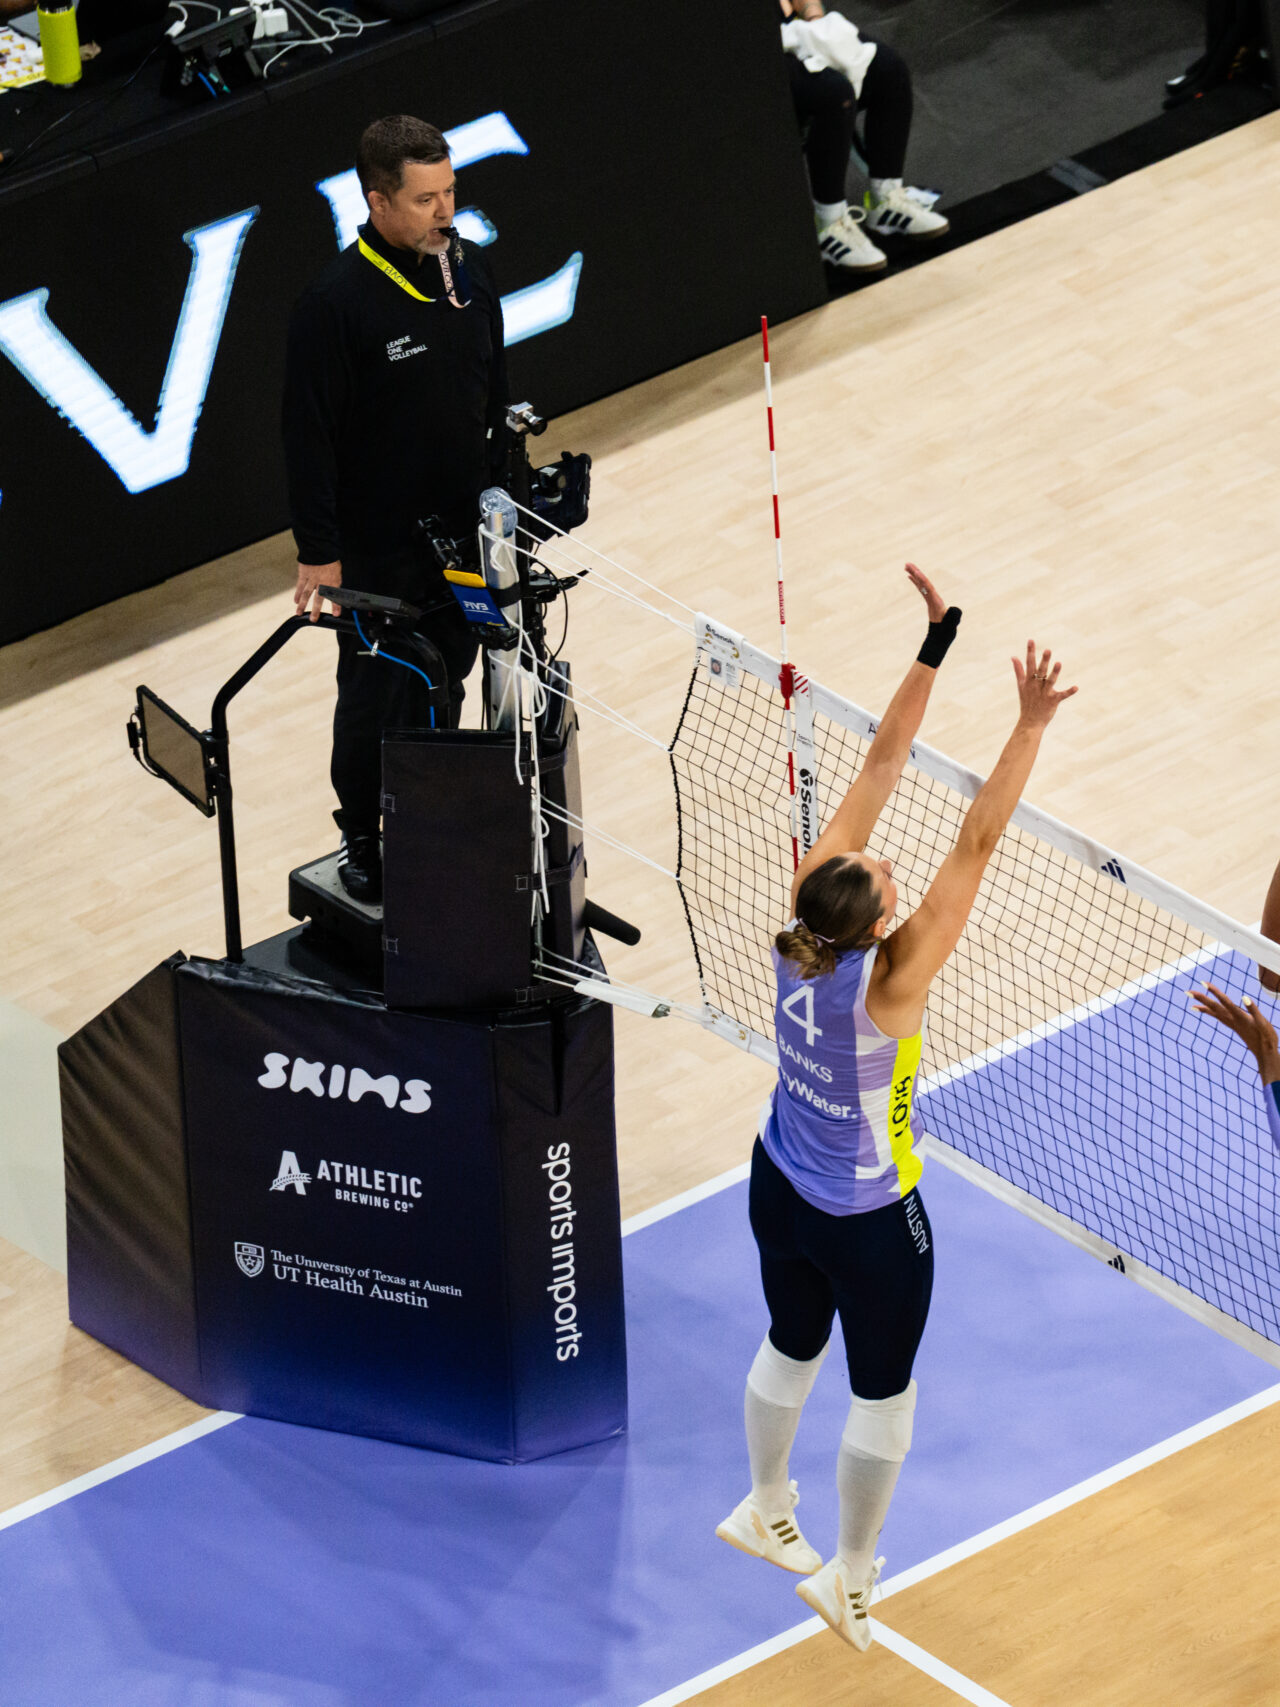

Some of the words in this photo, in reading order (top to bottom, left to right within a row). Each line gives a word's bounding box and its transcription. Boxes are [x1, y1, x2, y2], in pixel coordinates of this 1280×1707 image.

[386, 335, 411, 349] LEAGUE
[387, 346, 402, 355] ONE
[388, 344, 428, 361] VOLLEYBALL
[782, 984, 822, 1047] 4
[779, 1033, 833, 1083] BANKS
[257, 1052, 432, 1114] SKIMS
[317, 1159, 423, 1198] ATHLETIC
[335, 1188, 390, 1209] BREWING
[541, 1142, 578, 1240] sports
[904, 1194, 930, 1255] AUSTIN
[270, 1249, 293, 1263] The
[294, 1254, 355, 1278] University
[357, 1268, 371, 1279] of
[373, 1269, 407, 1287] Texas
[409, 1279, 420, 1289] at
[423, 1280, 463, 1297] Austin
[272, 1264, 301, 1283] UT
[305, 1270, 365, 1296] Health
[369, 1283, 429, 1309] Austin
[546, 1242, 583, 1362] imports
